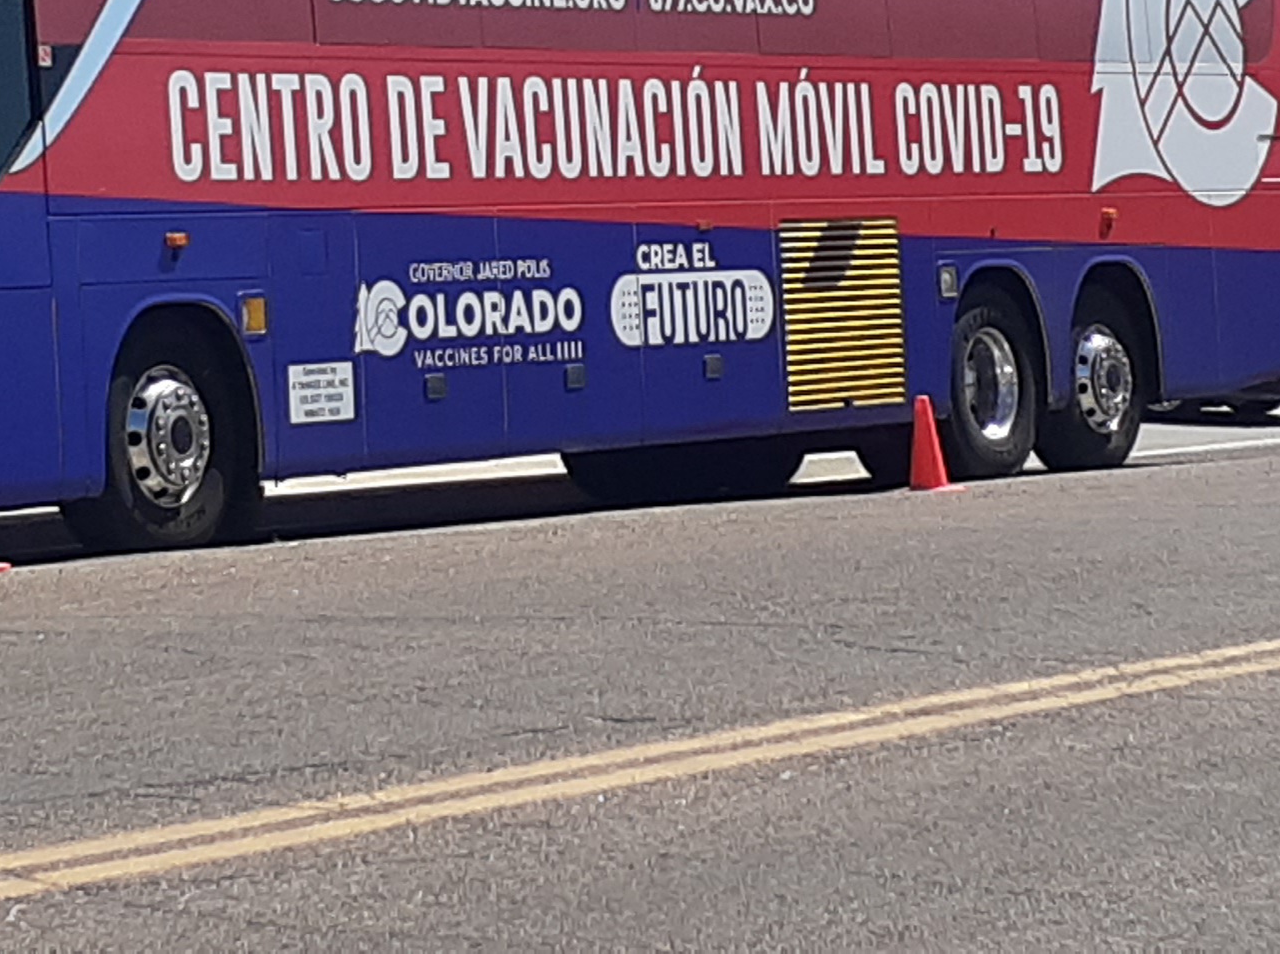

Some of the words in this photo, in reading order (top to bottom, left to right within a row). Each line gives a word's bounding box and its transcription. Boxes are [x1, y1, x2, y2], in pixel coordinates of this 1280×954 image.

[168, 69, 372, 182] CENTRO
[386, 74, 451, 179] DE
[457, 65, 744, 180] VACUNACIÓN
[755, 67, 886, 177] MÓVIL
[894, 81, 1063, 175] COVID-19
[409, 260, 474, 283] GOVERNOR
[477, 261, 515, 280] JARED
[516, 259, 552, 279] POLIS
[636, 243, 690, 271] CREA
[692, 242, 716, 268] EL
[354, 279, 583, 357] COLORADO
[640, 278, 748, 346] FUTURO
[413, 346, 489, 369] VACCINES
[493, 345, 524, 364] FOR
